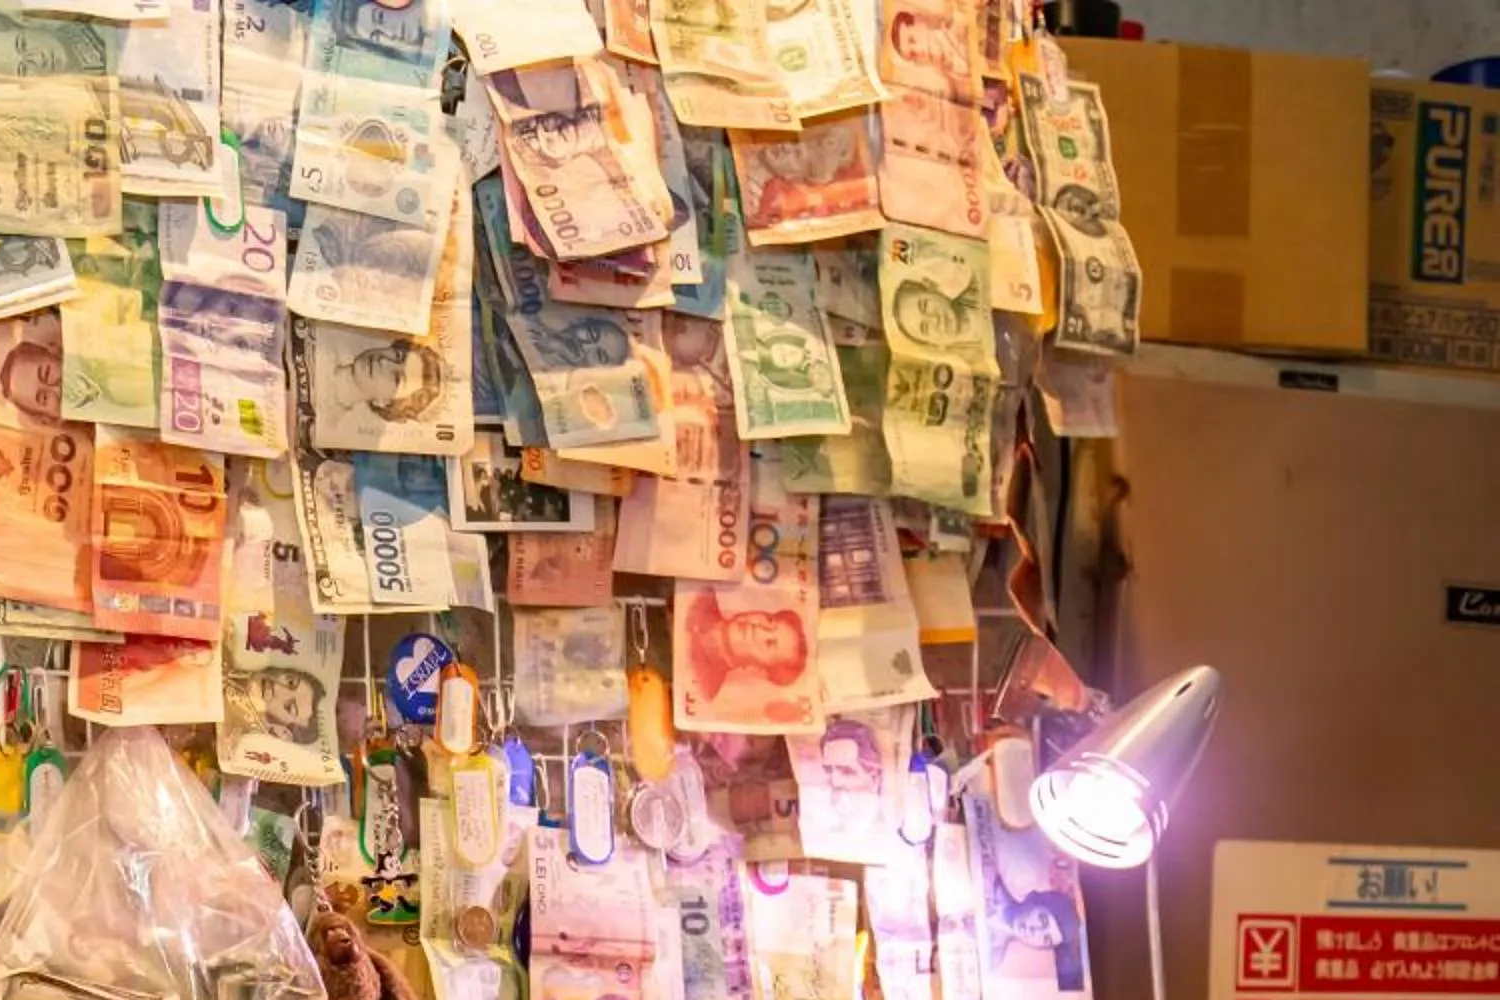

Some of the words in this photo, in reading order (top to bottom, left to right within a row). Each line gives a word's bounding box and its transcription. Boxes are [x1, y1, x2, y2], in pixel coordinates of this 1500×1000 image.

[246, 14, 266, 34] 2
[242, 220, 277, 274] 20
[175, 389, 200, 433] 20
[436, 423, 455, 442] 10
[175, 463, 217, 515] 10
[272, 541, 300, 564] 5
[371, 510, 402, 594] 50000
[749, 511, 782, 585] 100
[679, 895, 711, 937] 10
